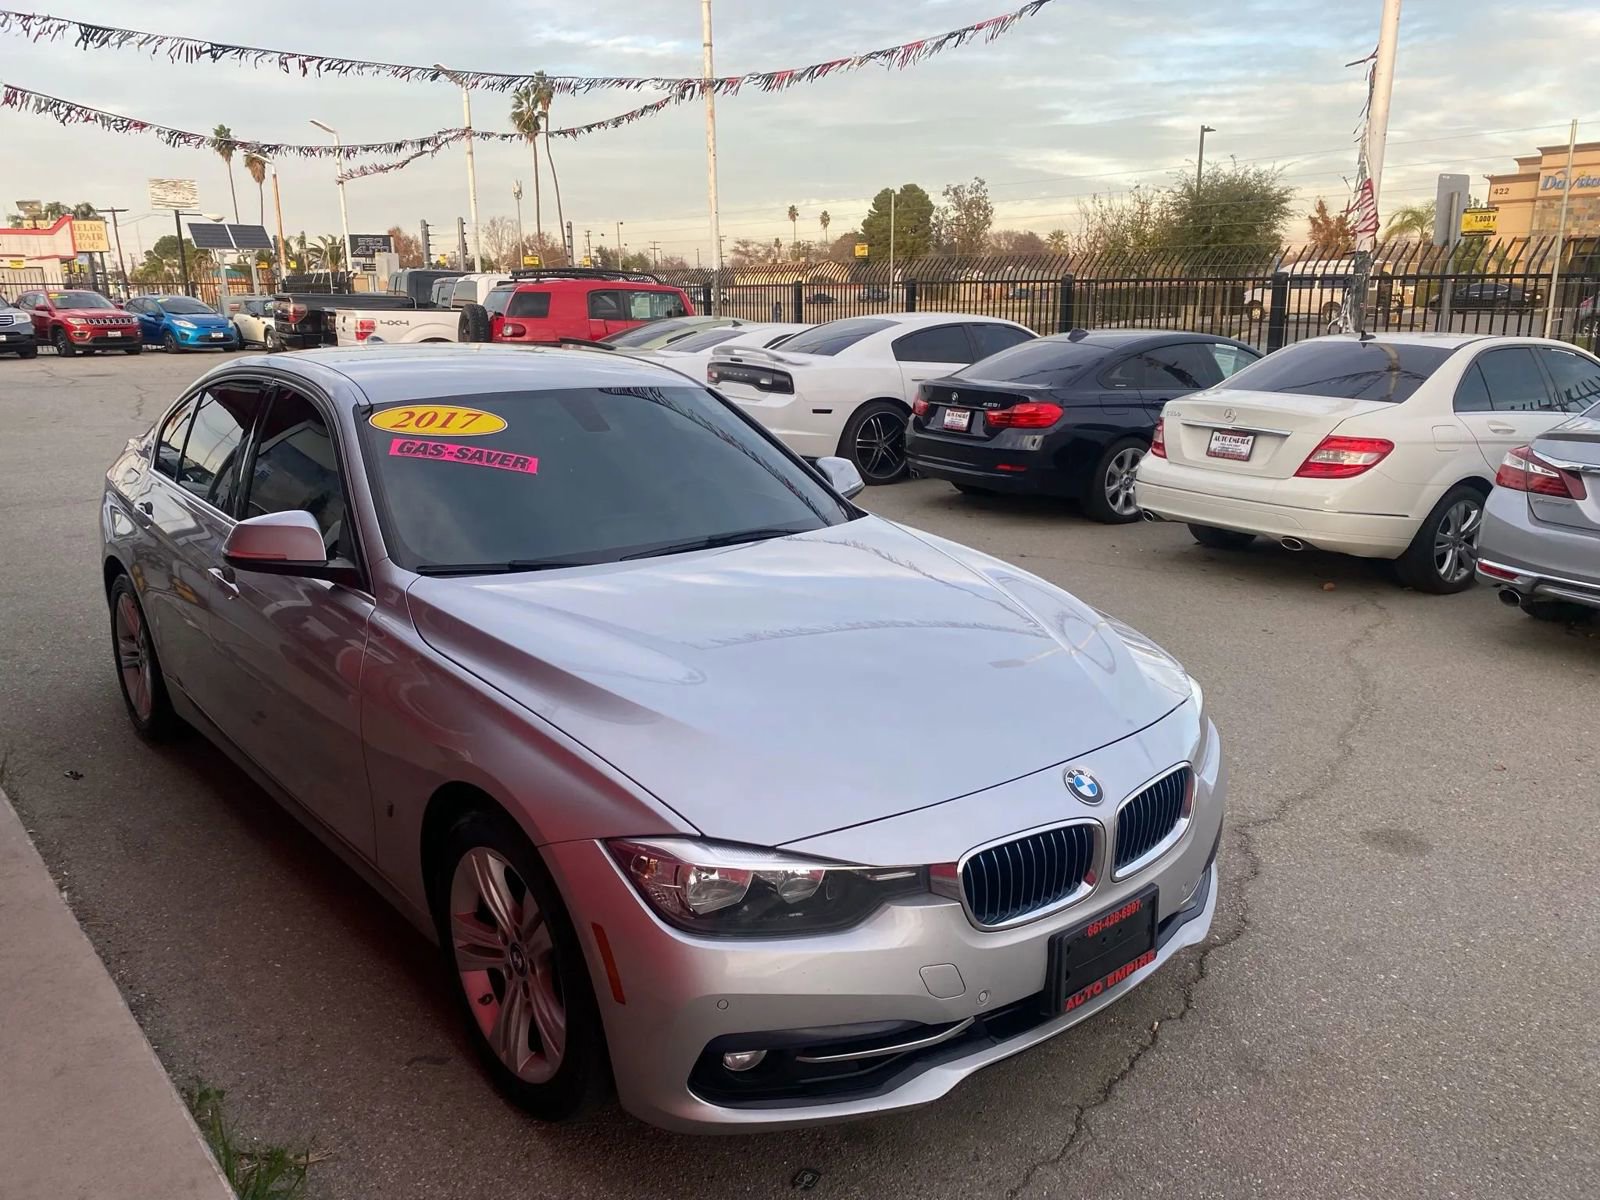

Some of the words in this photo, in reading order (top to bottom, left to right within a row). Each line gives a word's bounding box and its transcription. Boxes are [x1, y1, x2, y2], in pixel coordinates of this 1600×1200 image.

[1493, 187, 1510, 195] 422
[391, 411, 483, 429] 2017
[397, 441, 532, 472] GAS-SAVER
[1065, 981, 1104, 1012] AUTO
[1106, 949, 1157, 989] EMPIRE
